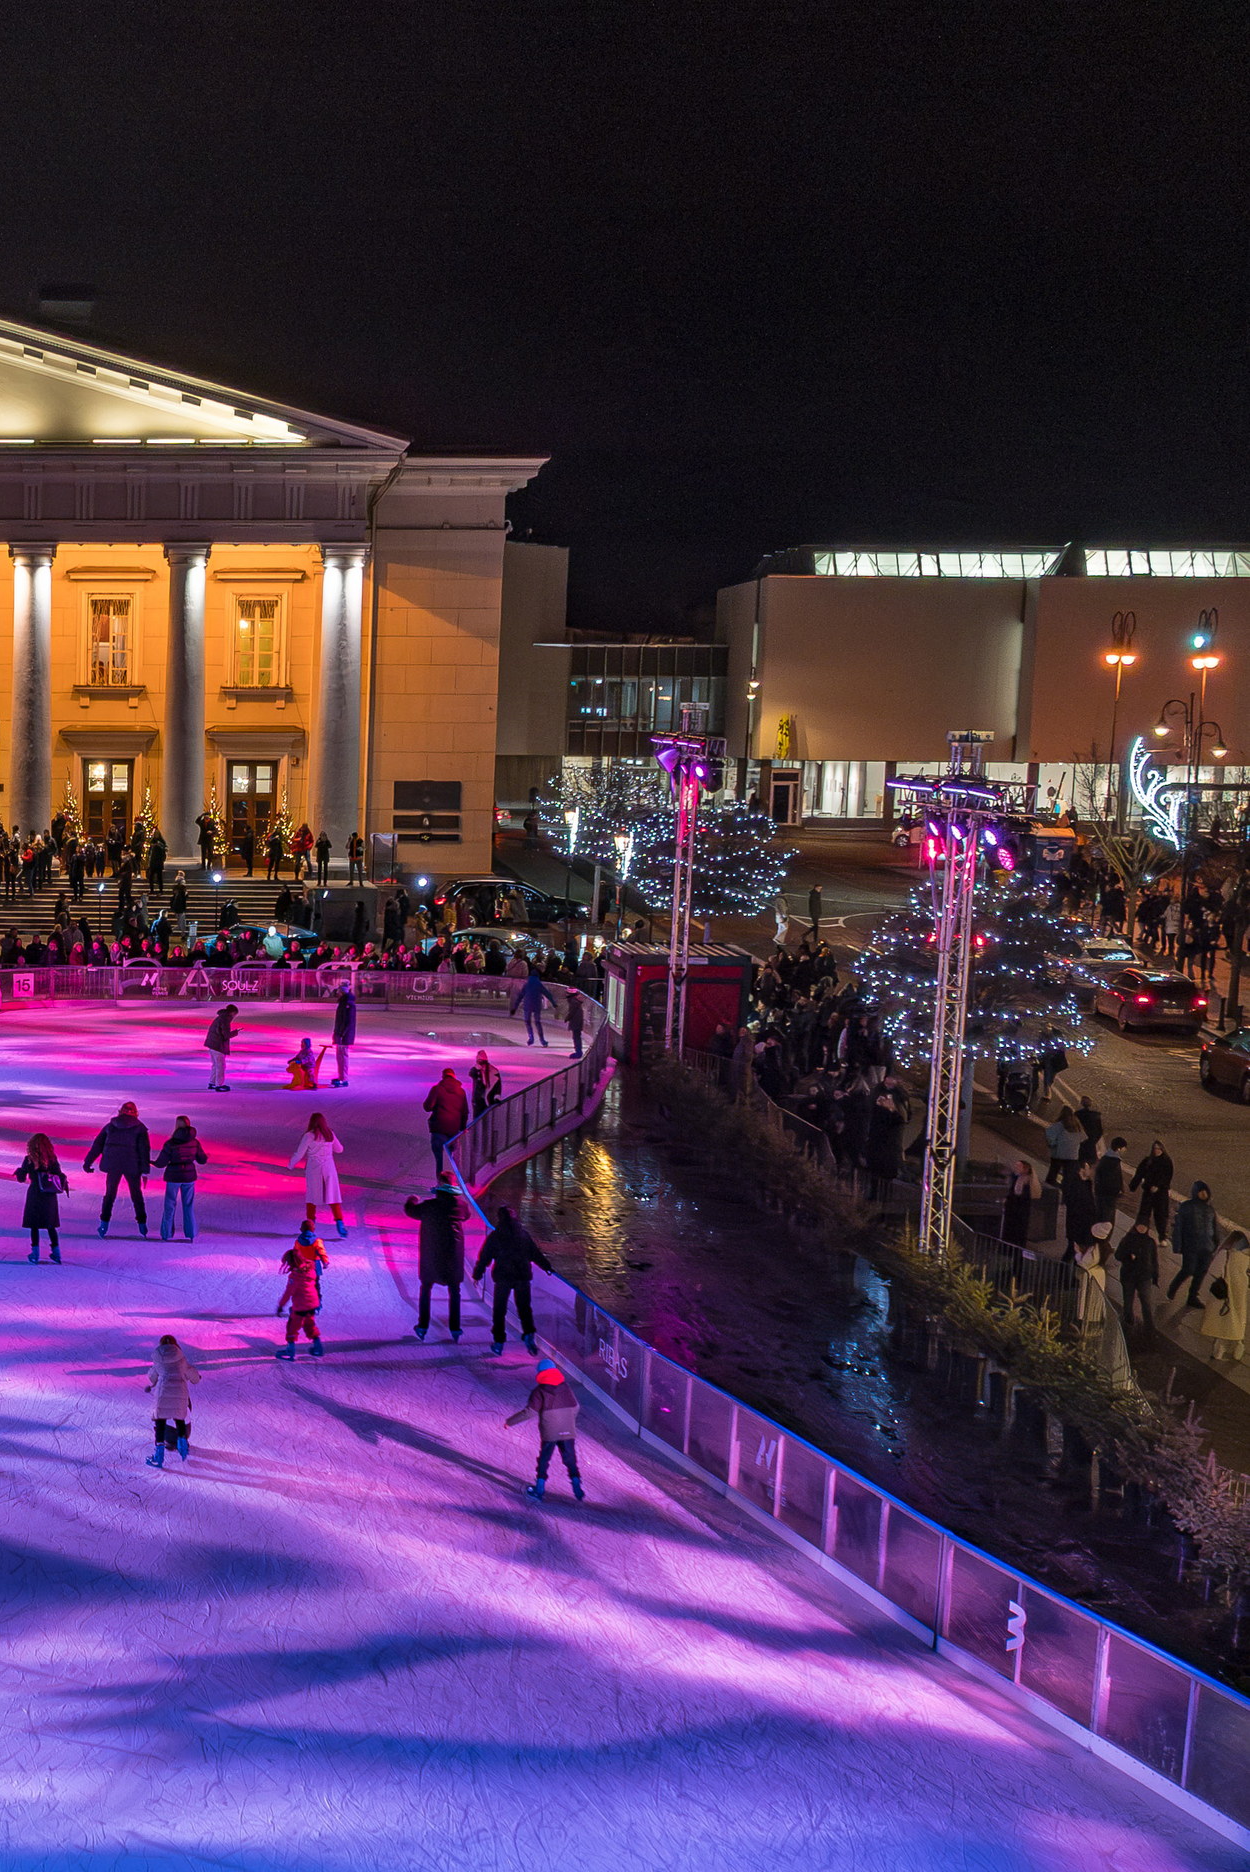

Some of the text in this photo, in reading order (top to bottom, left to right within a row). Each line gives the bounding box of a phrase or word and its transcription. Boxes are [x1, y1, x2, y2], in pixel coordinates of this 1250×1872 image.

[15, 979, 31, 992] 15
[222, 980, 259, 991] SOULZ
[598, 1337, 628, 1379] RIBAS
